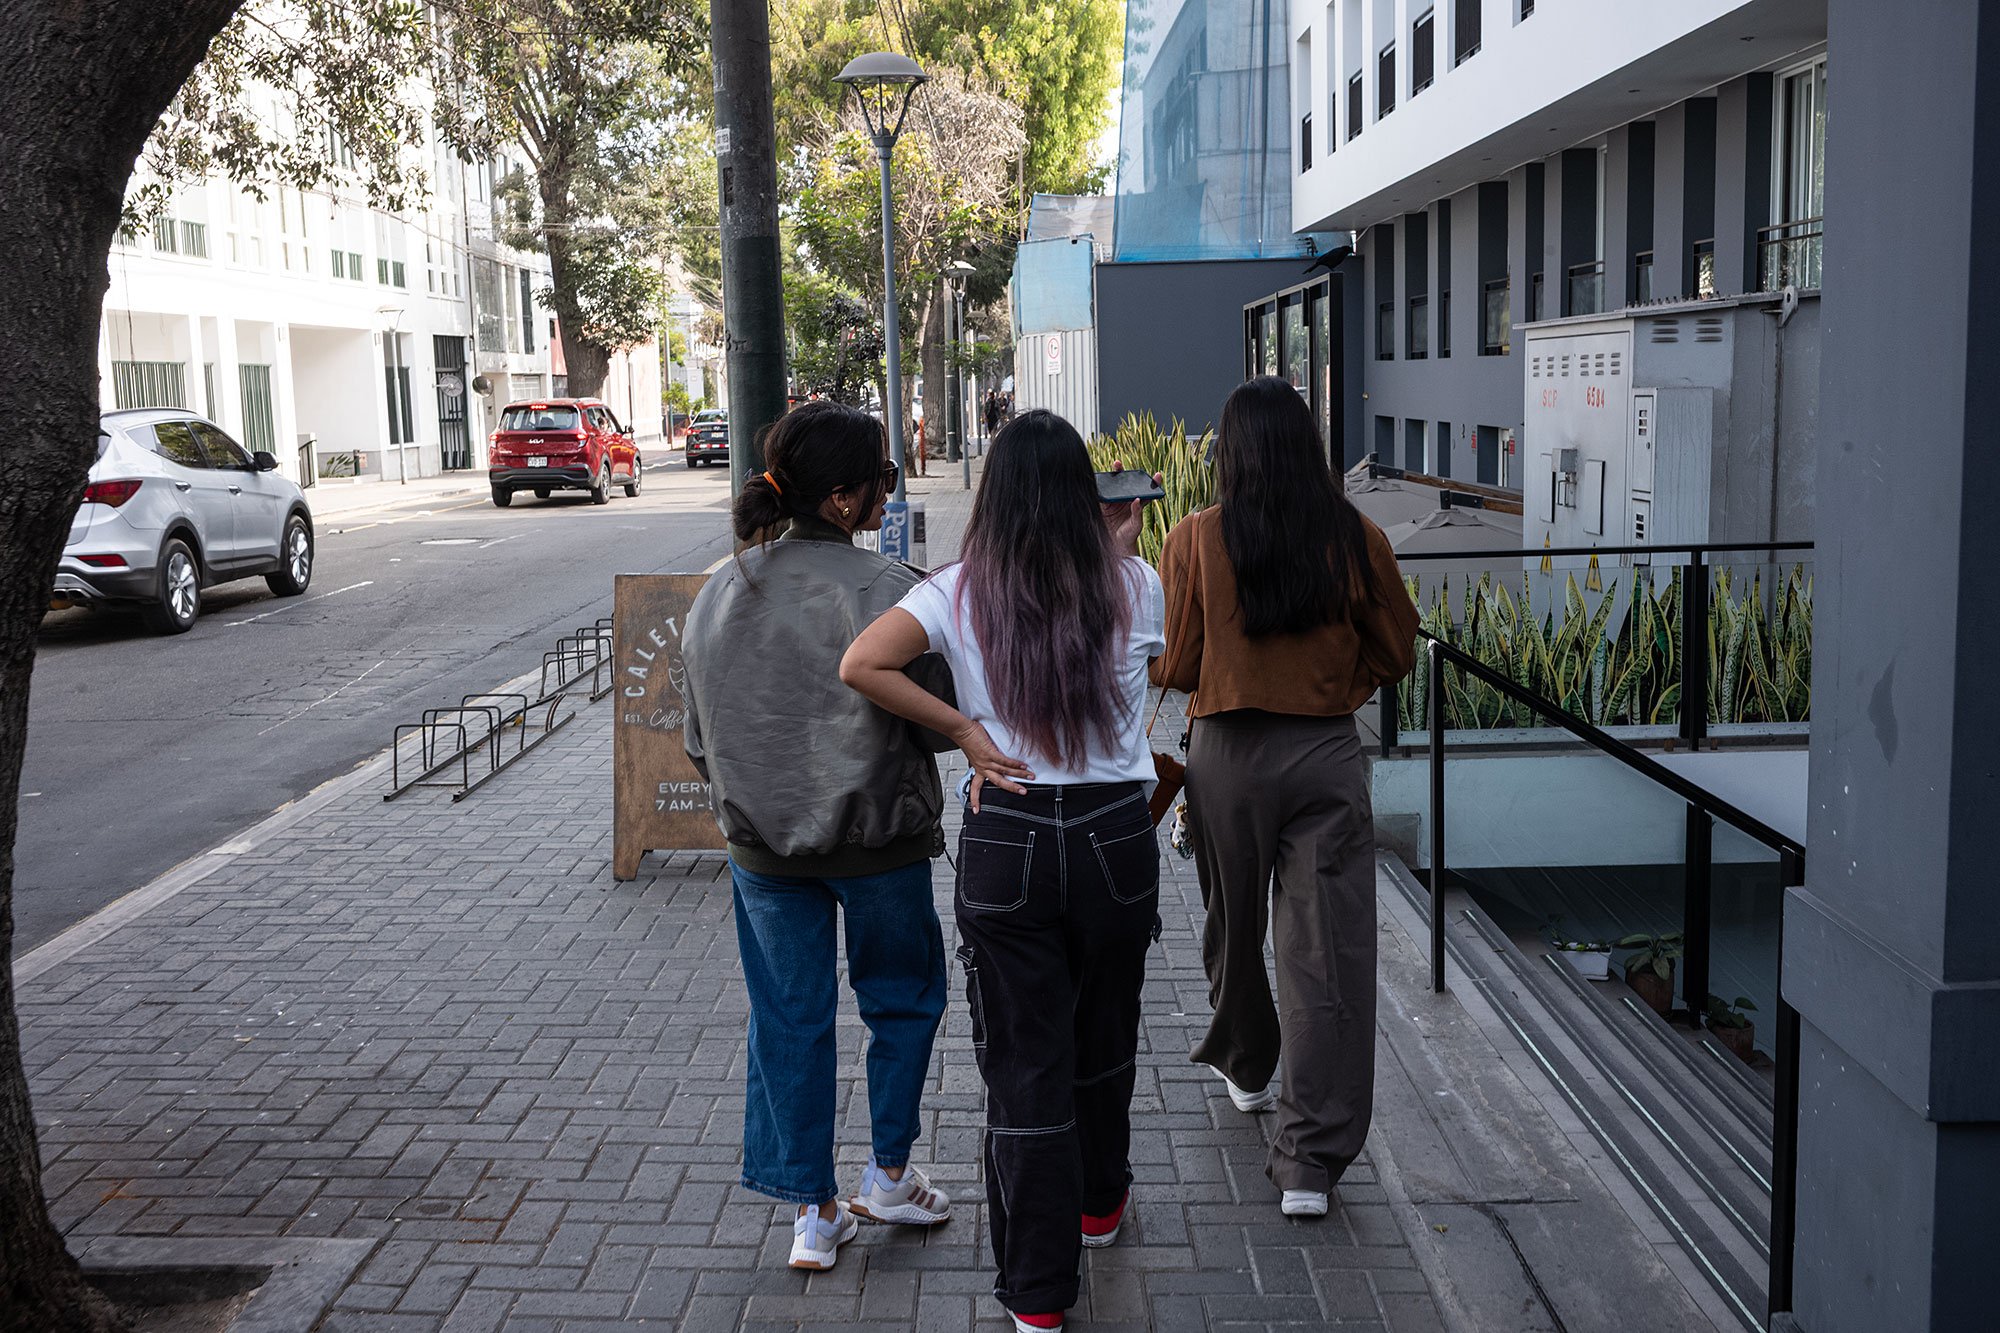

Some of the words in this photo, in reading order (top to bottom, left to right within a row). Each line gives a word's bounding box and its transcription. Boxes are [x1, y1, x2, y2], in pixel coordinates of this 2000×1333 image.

[1587, 386, 1604, 408] 6584
[624, 713, 644, 723] EST.
[659, 782, 710, 794] EVERY
